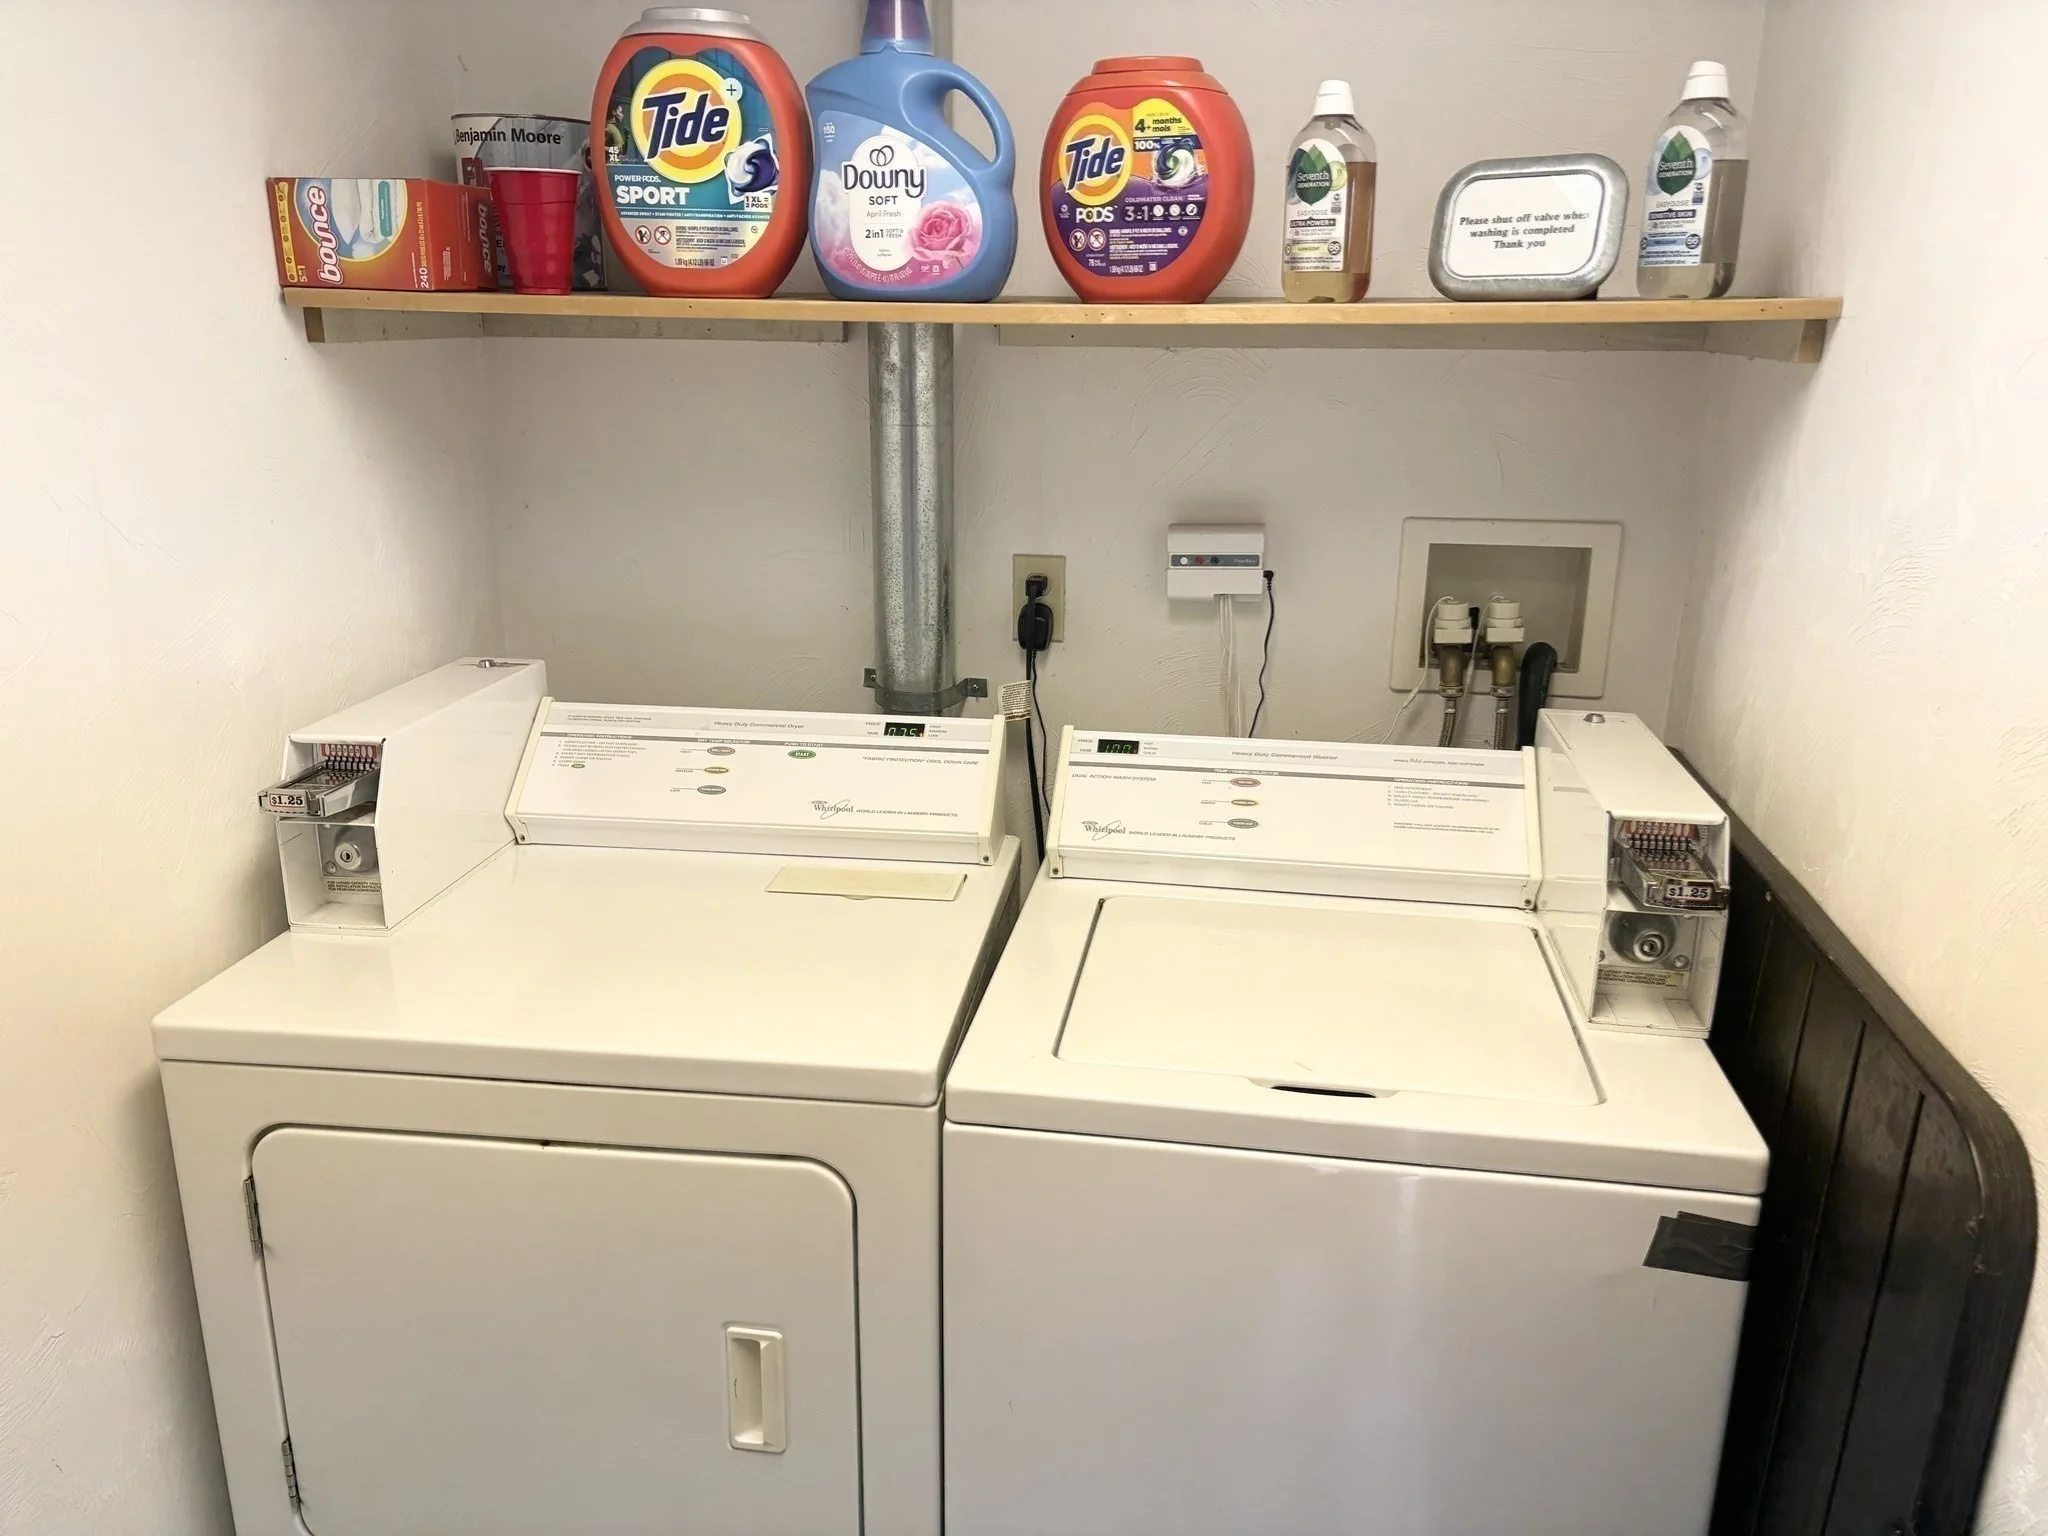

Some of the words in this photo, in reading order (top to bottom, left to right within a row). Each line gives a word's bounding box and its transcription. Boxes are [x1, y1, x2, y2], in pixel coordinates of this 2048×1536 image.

[642, 92, 729, 160] Tide
[456, 128, 506, 145] Benjamin
[511, 128, 562, 145] Moore
[1134, 141, 1160, 150] 100%
[609, 154, 620, 162] XL
[1066, 137, 1125, 191] Tide
[844, 165, 924, 198] Downy
[1298, 171, 1329, 181] Seventh
[616, 186, 690, 206] SPORT
[869, 196, 898, 205] SOFT
[866, 211, 882, 219] April
[1076, 206, 1114, 223] PODS
[1460, 217, 1489, 226] Please
[1491, 215, 1513, 224] shut
[1516, 214, 1531, 223] off
[1534, 213, 1560, 222] valve
[307, 186, 344, 284] bounce
[1470, 229, 1508, 239] washing
[1512, 227, 1520, 236] is
[1523, 225, 1575, 237] completed
[478, 204, 492, 275] bounce
[1494, 240, 1523, 249] Thank
[1526, 241, 1546, 250] you
[420, 267, 429, 289] 240
[272, 796, 304, 806] $1.25
[814, 803, 854, 814] Whirlpool
[1084, 824, 1126, 835] Whirlpool
[1668, 887, 1708, 899] $1.25
